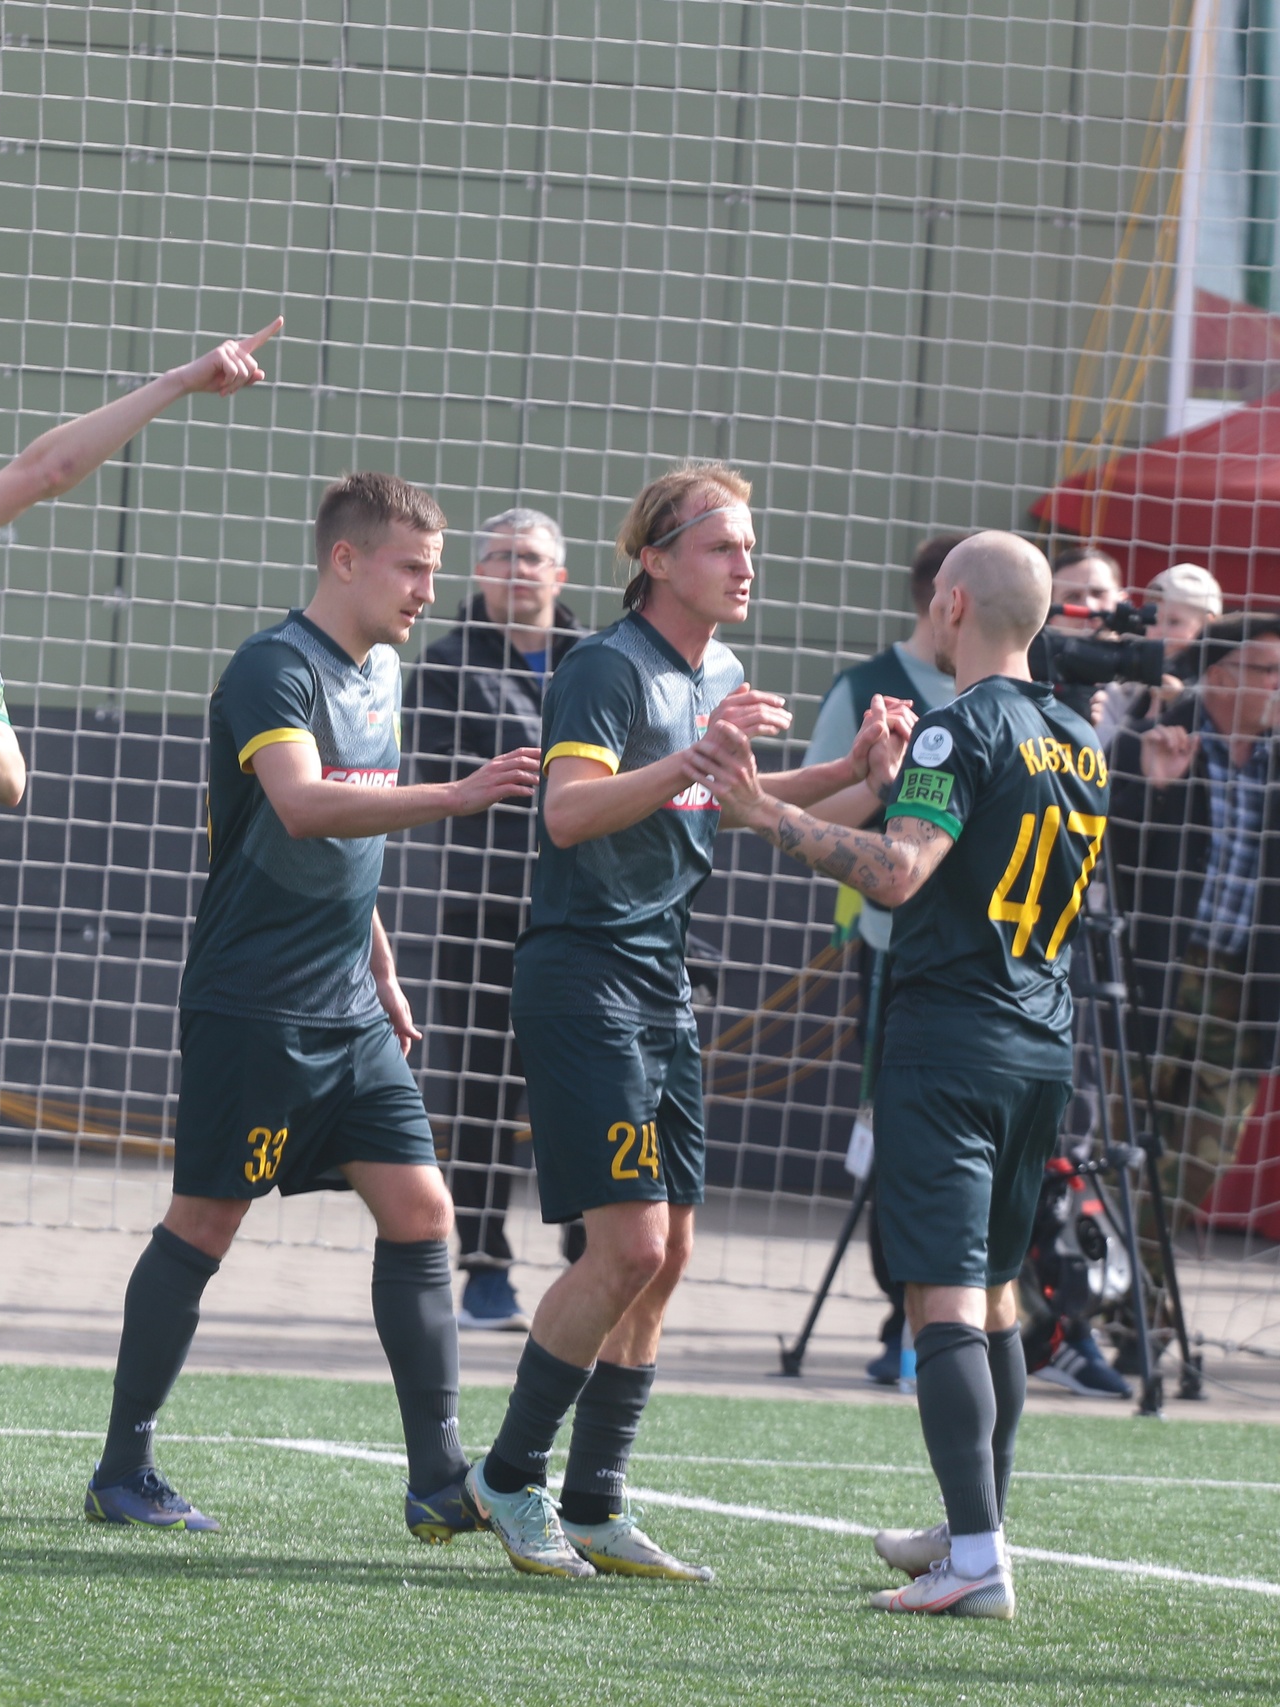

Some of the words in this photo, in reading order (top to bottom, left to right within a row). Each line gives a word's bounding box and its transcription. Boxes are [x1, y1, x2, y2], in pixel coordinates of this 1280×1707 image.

[902, 785, 944, 805] ERA
[908, 773, 948, 789] BET
[988, 805, 1107, 961] 47
[244, 1126, 288, 1182] 33
[607, 1121, 659, 1180] 24
